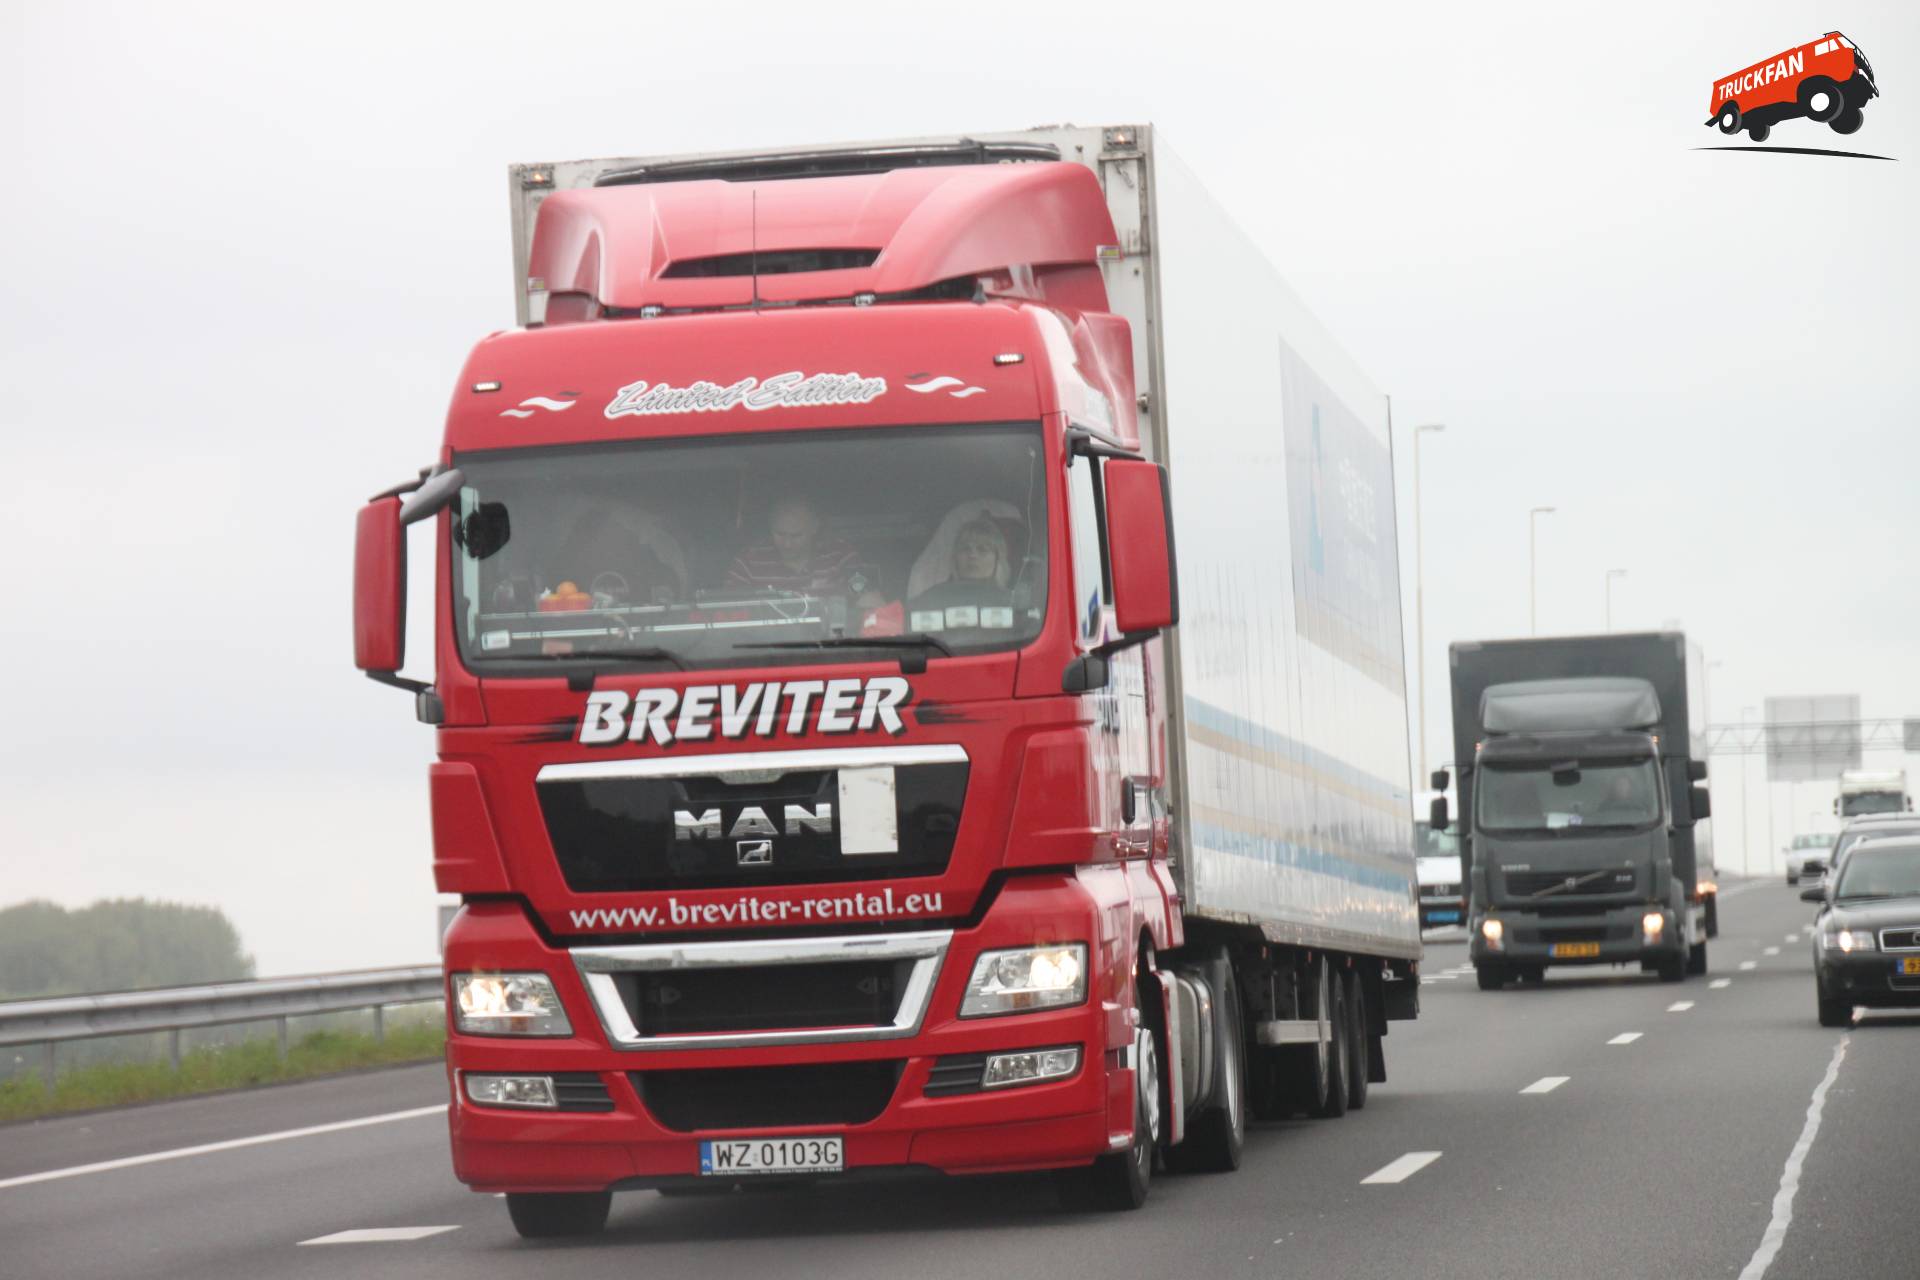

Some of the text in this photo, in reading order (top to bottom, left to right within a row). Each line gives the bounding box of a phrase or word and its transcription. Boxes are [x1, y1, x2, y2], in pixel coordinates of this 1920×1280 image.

[604, 371, 887, 419] Limited Edition
[578, 676, 911, 746] BREVITER
[674, 802, 832, 840] MAN
[569, 888, 943, 929] www.breviter-rental.eu
[715, 1141, 839, 1168] WZ 0103G
